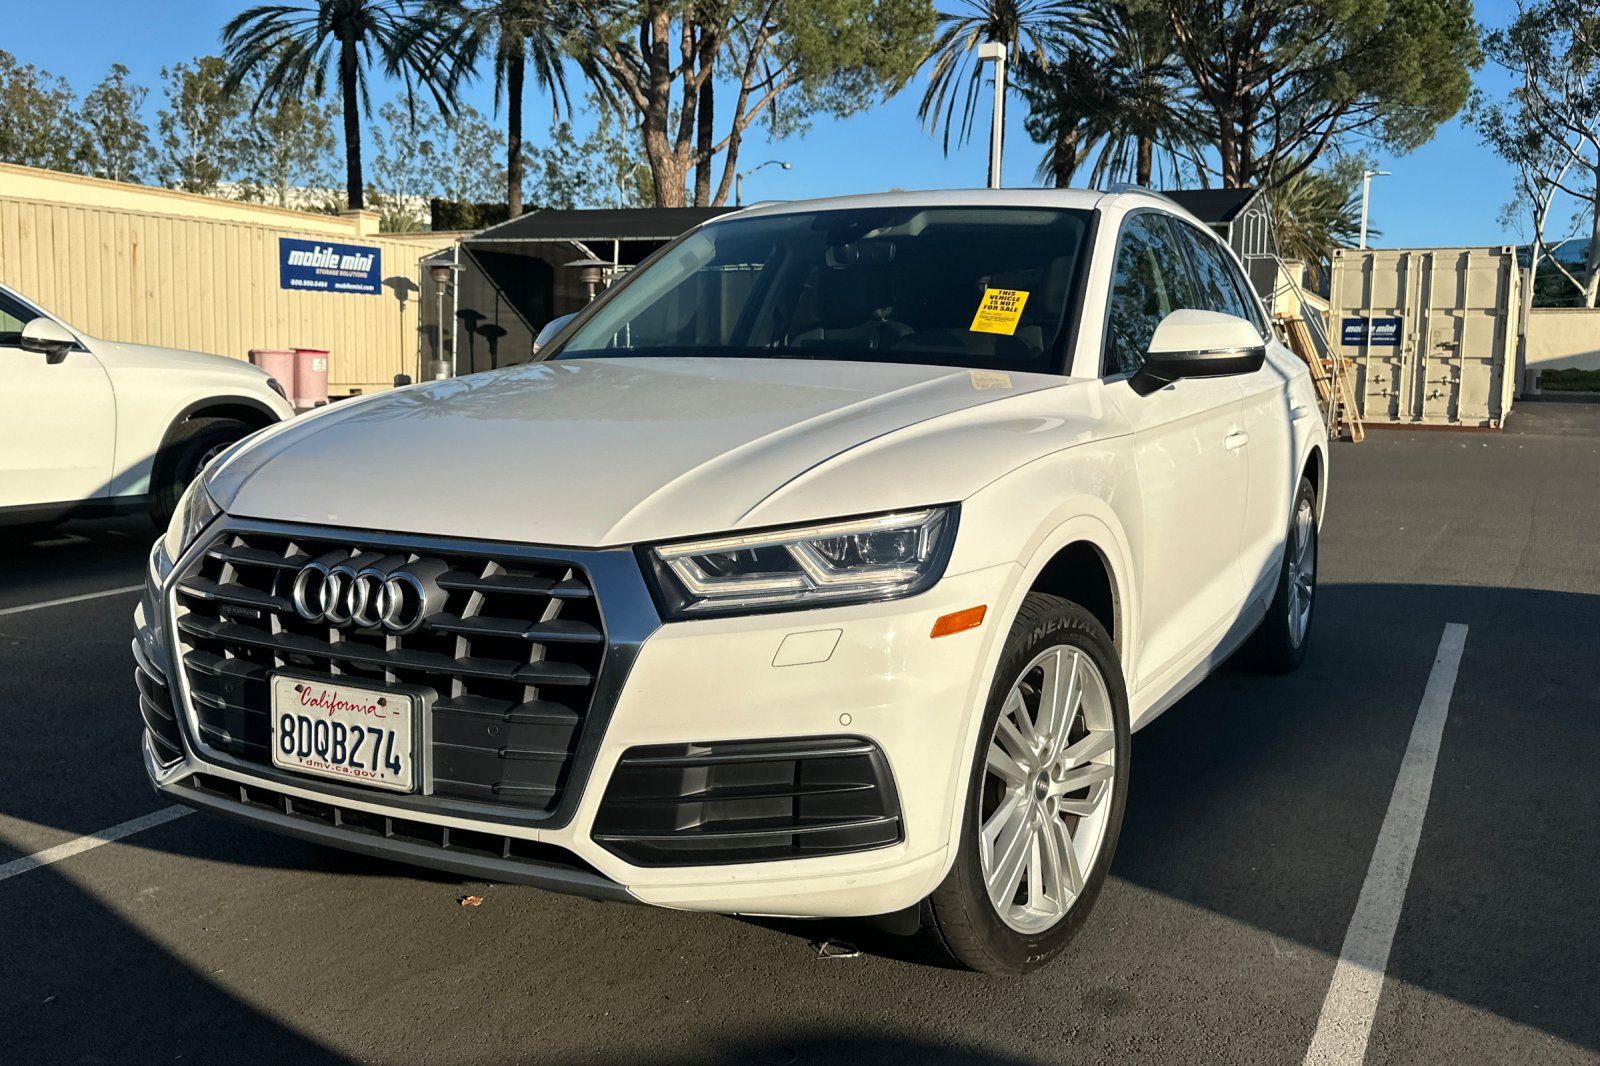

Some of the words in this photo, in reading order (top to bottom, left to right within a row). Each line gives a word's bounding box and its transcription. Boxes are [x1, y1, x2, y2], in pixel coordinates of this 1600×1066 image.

[288, 246, 340, 268] mobile
[340, 253, 374, 271] mini
[1376, 324, 1396, 332] mini
[301, 686, 386, 718] California
[280, 713, 402, 775] 8DQB274
[306, 759, 376, 778] dmv.ca.gov
